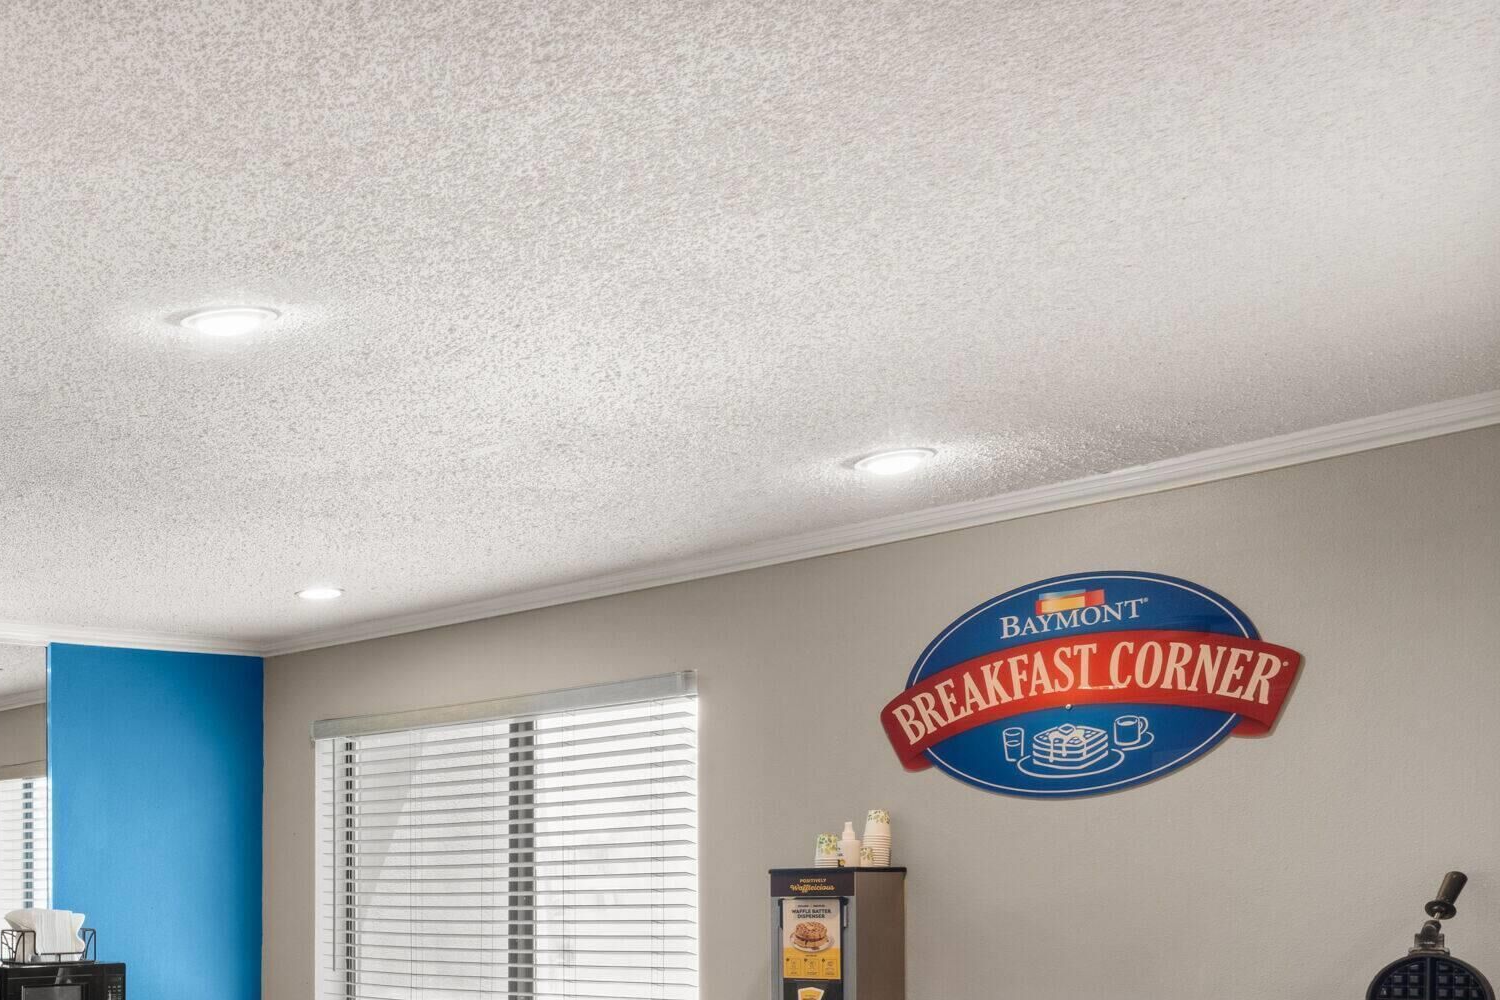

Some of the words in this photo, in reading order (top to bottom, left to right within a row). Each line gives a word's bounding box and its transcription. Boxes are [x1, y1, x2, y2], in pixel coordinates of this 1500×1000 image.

[999, 598, 1143, 640] BAYMONT
[892, 642, 1097, 746] BREAKFAST
[1109, 641, 1282, 706] CORNER
